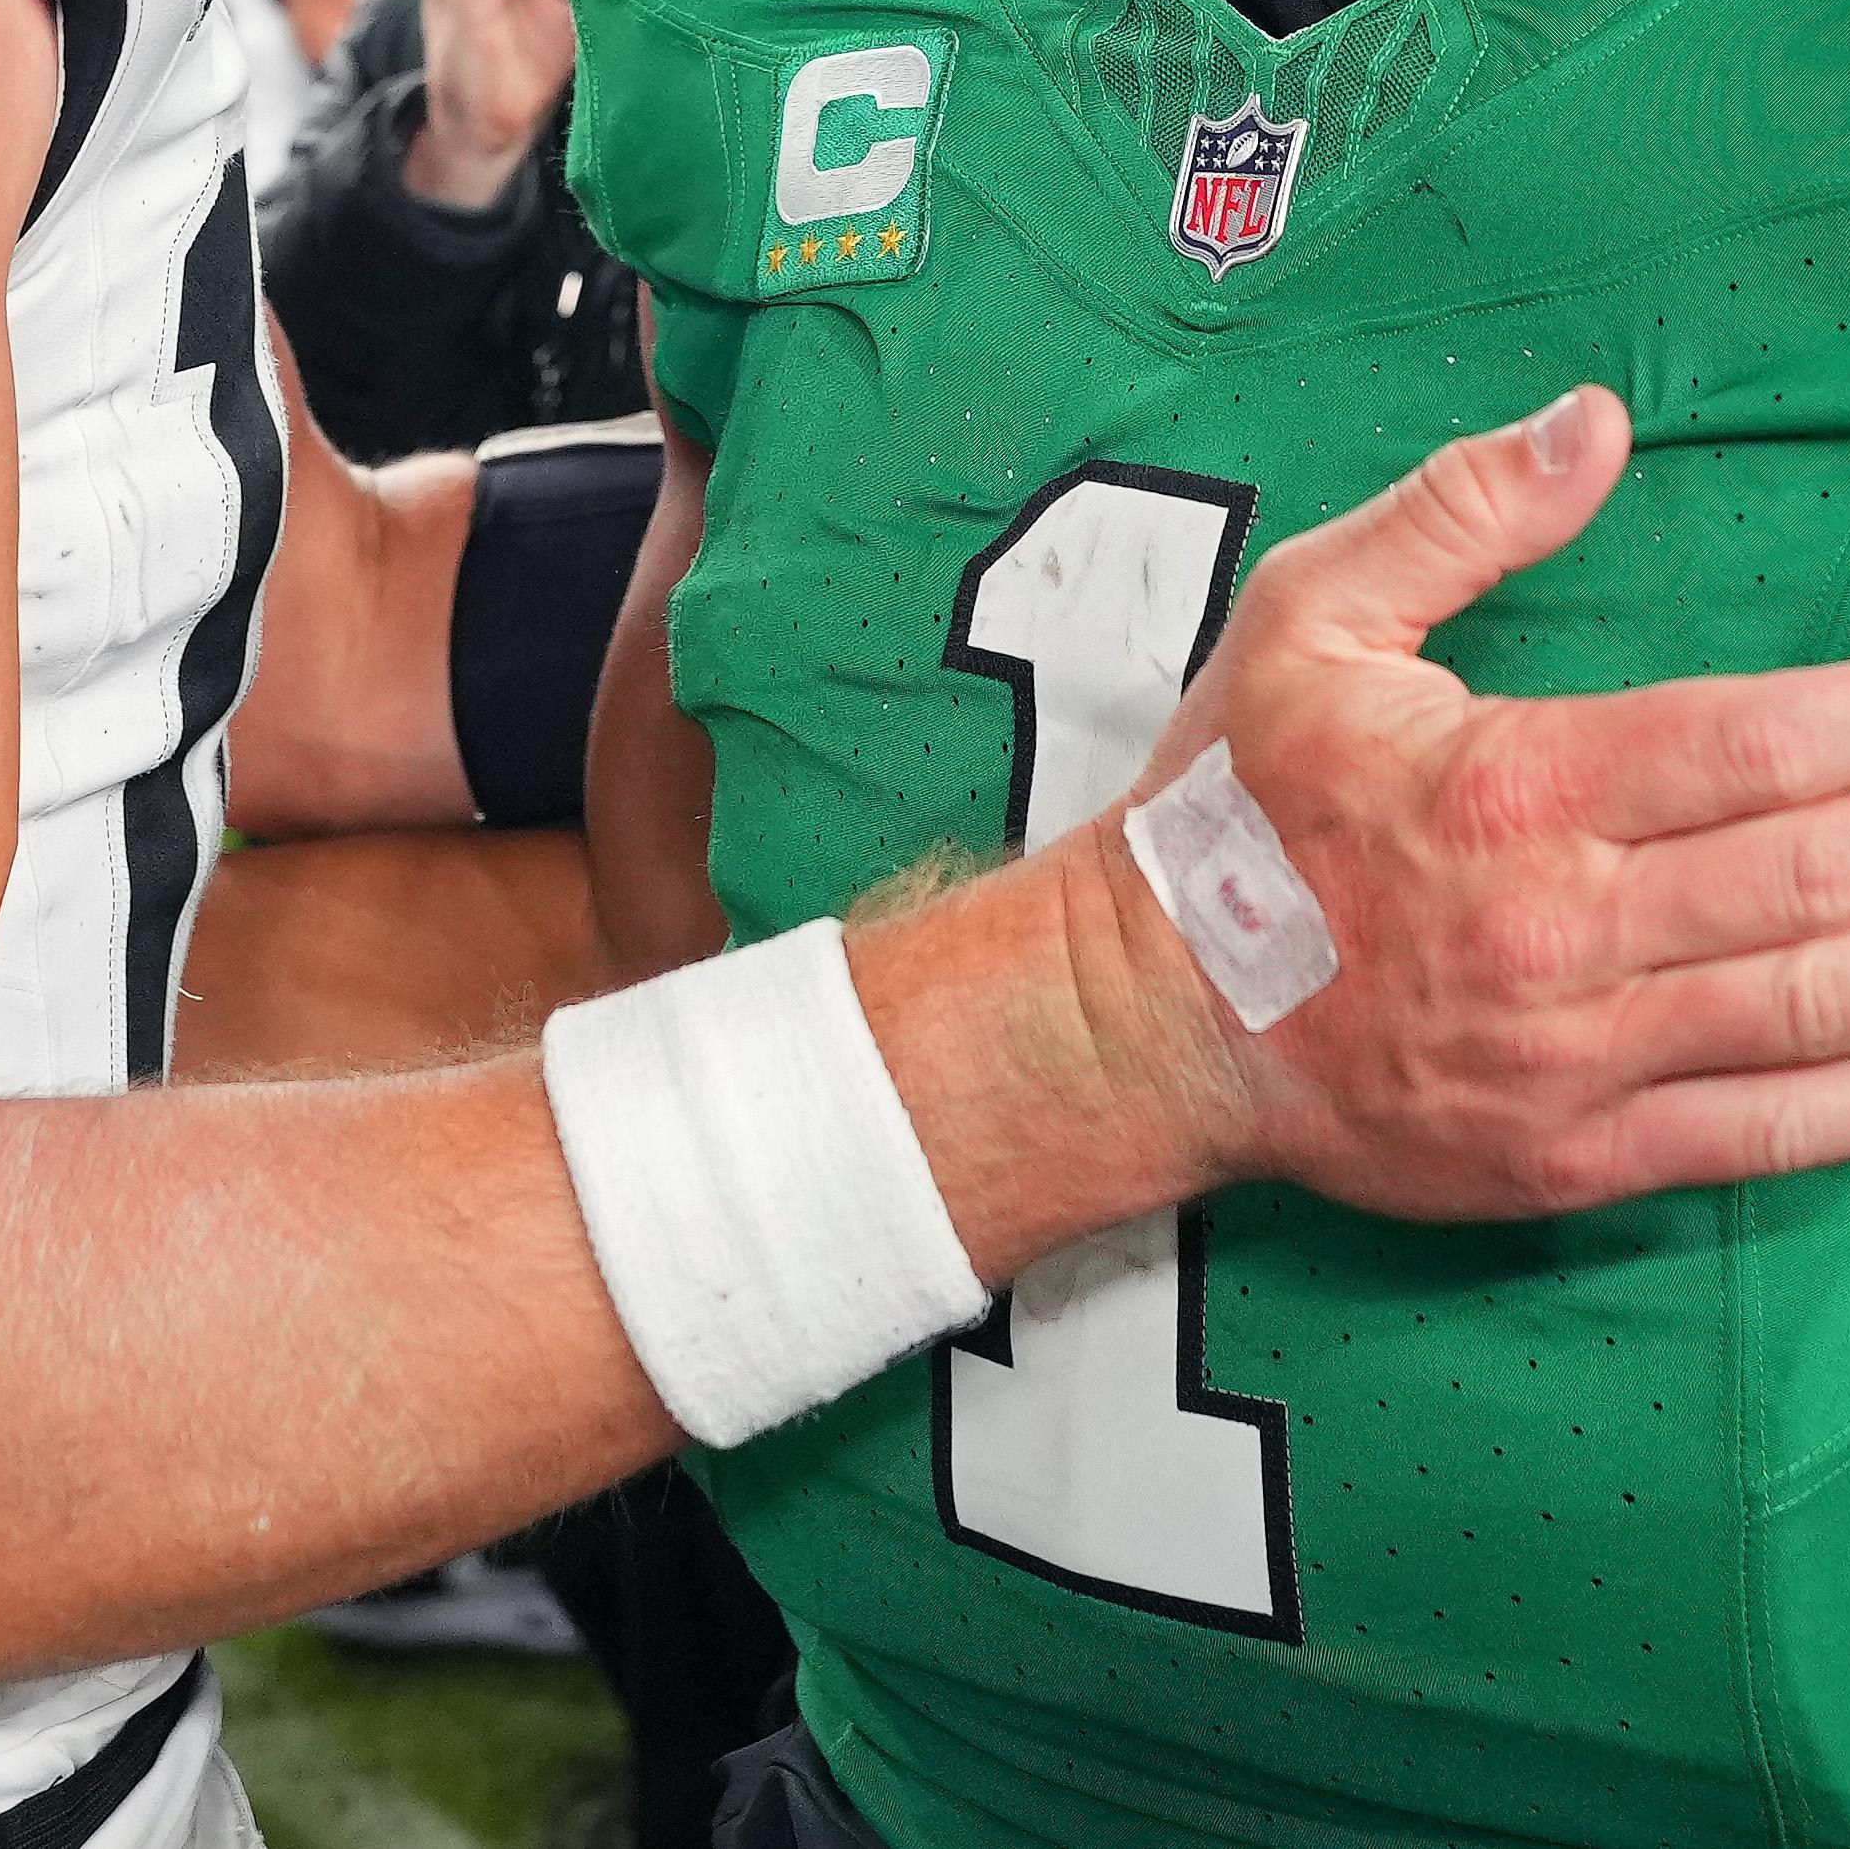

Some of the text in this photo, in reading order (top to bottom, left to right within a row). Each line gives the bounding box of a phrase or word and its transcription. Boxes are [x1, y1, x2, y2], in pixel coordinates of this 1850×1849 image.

[775, 45, 931, 226] C
[1186, 176, 1268, 246] NFL
[933, 458, 1306, 1647] 1
